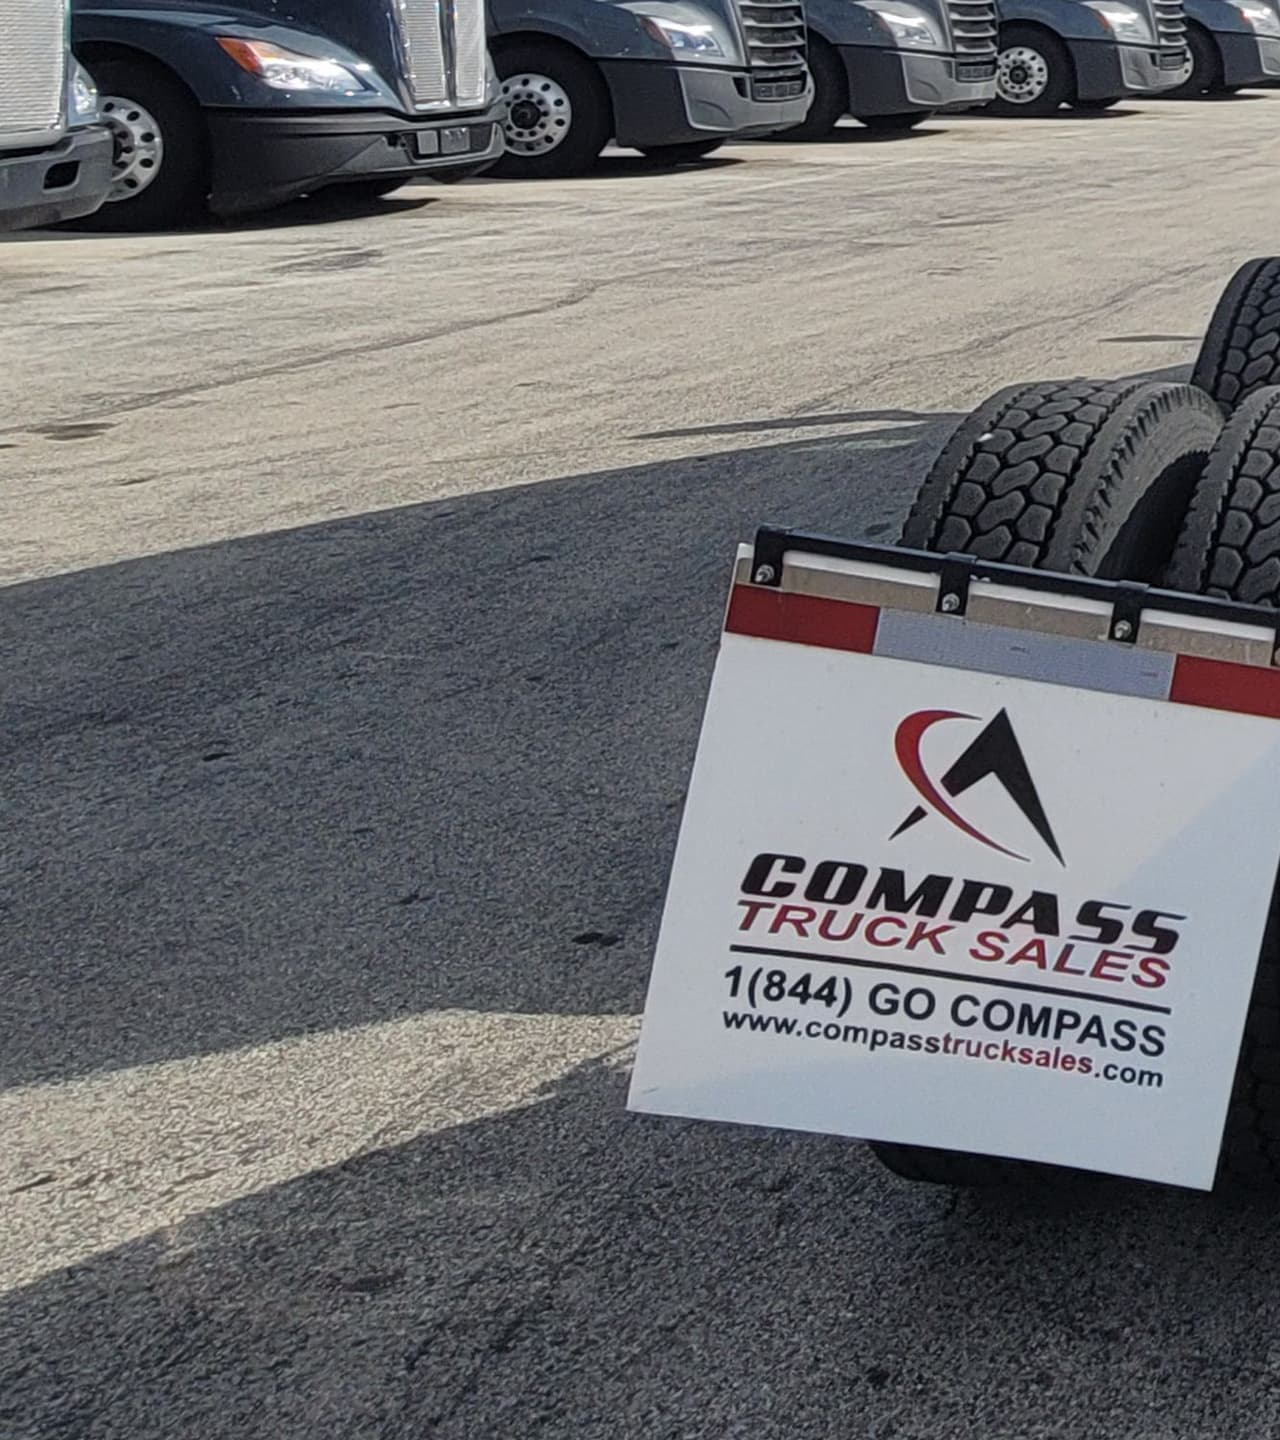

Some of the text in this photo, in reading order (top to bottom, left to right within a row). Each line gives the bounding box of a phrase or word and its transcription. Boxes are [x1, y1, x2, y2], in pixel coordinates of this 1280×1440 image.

[737, 900, 1171, 988] TRUCK SALES
[740, 852, 1188, 954] COMPASS
[723, 1010, 1164, 1088] www.compasstrucksales.com
[724, 965, 1167, 1057] 1(844) GO COMPASS
